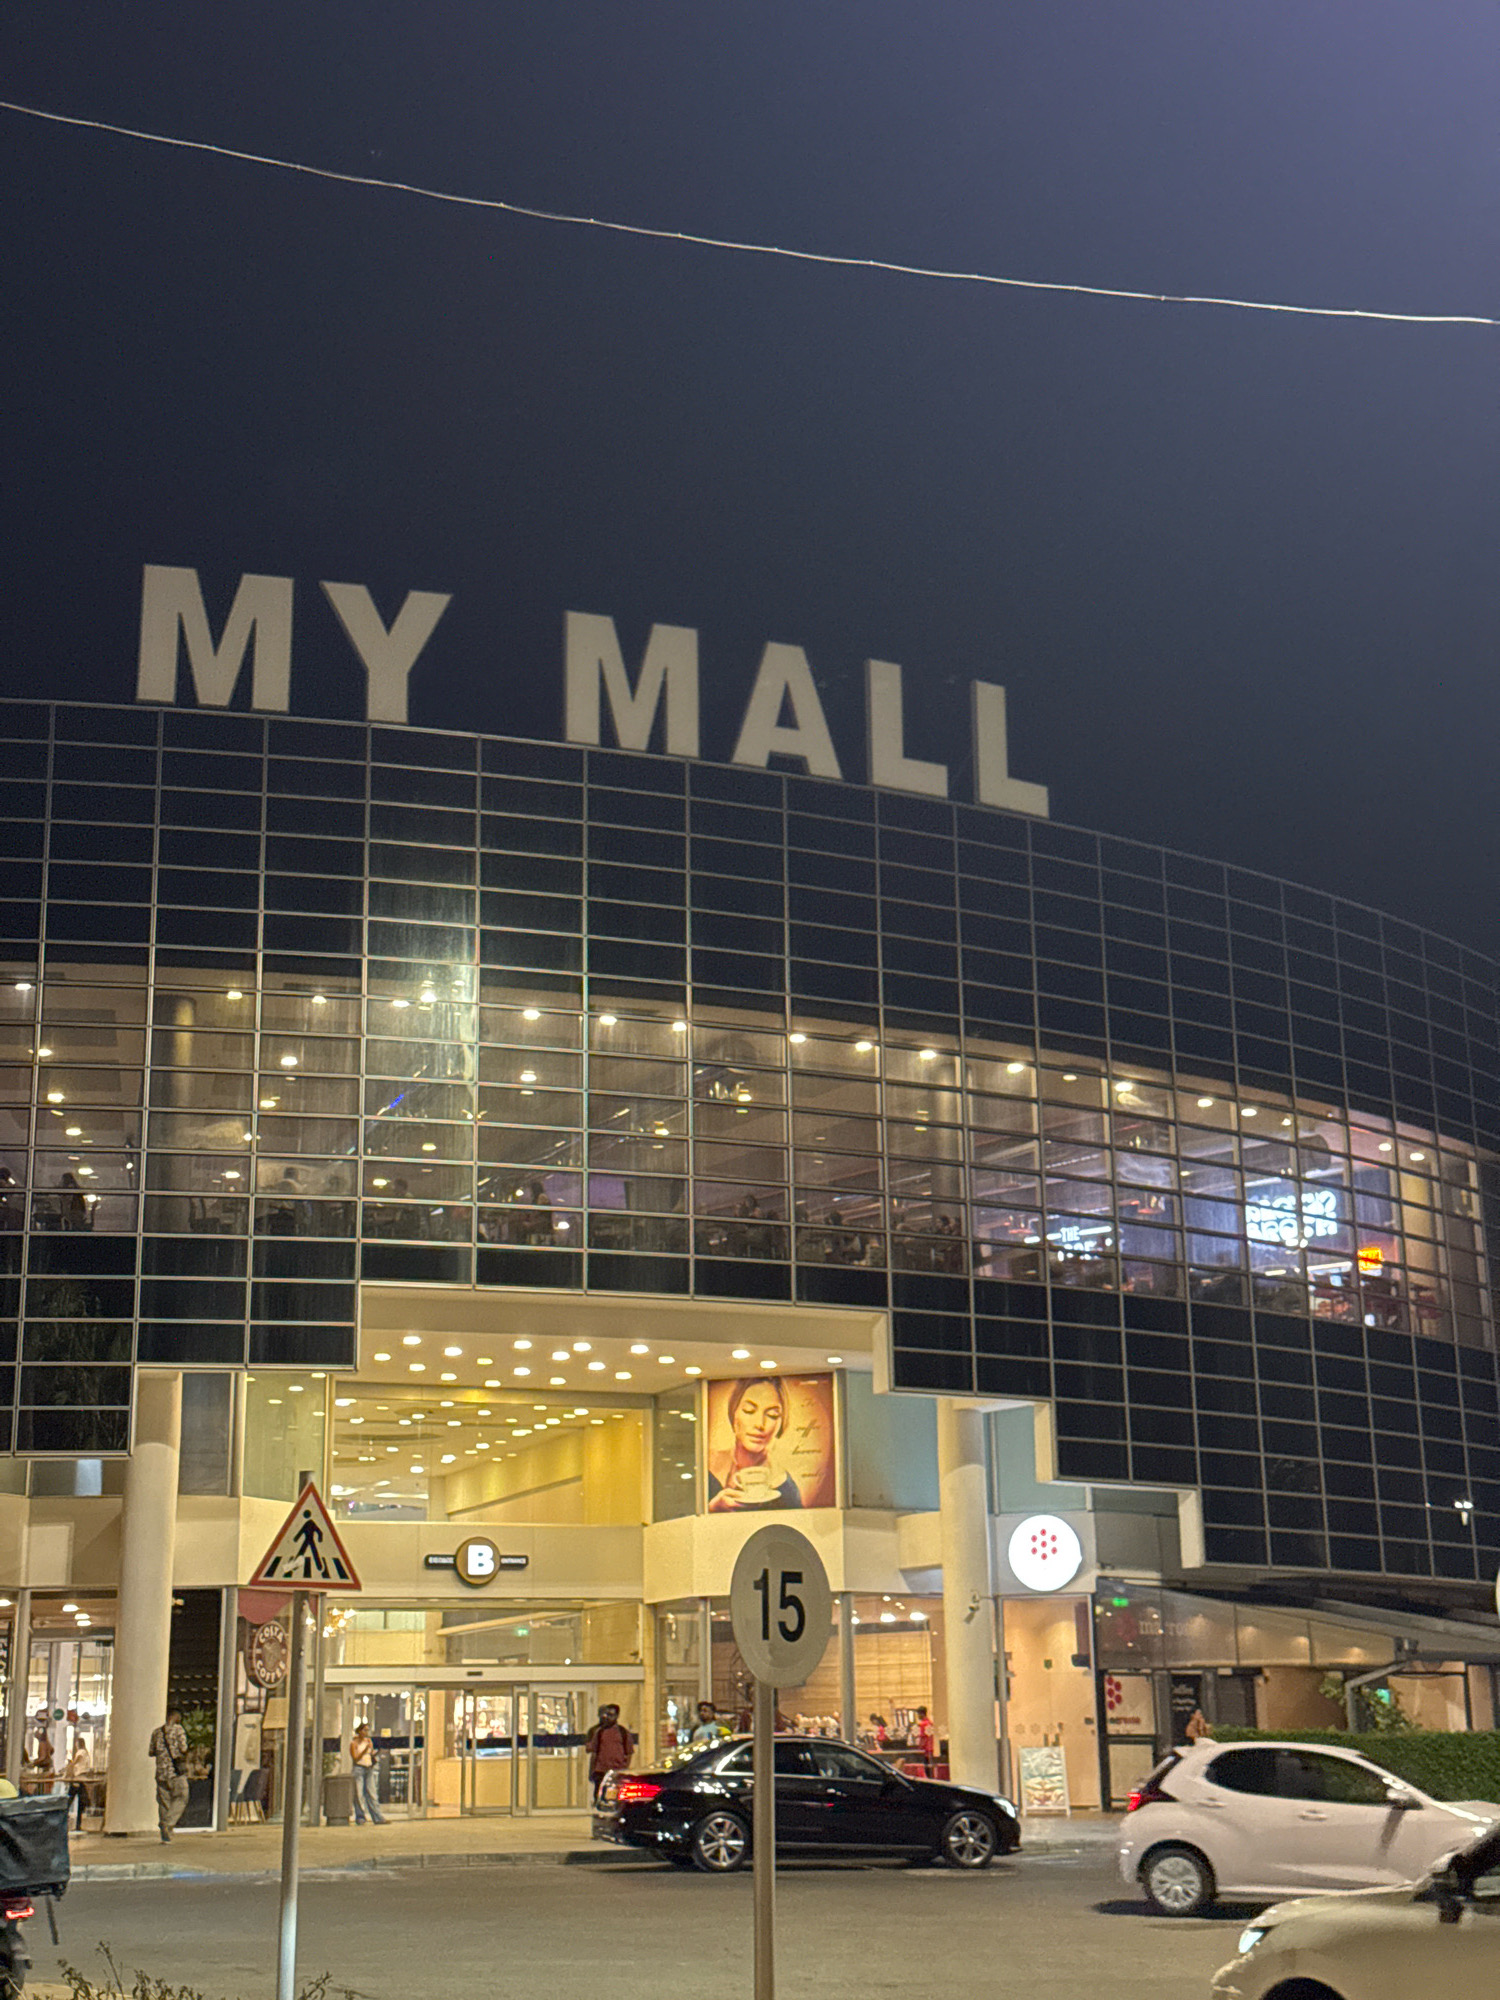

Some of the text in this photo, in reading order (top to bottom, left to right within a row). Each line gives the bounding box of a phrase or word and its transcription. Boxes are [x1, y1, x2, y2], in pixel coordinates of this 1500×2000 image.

[136, 563, 1050, 819] MY MALL
[467, 1544, 495, 1576] B
[753, 1568, 805, 1643] 15
[259, 1625, 284, 1644] COSTA
[256, 1659, 286, 1683] COFFEE
